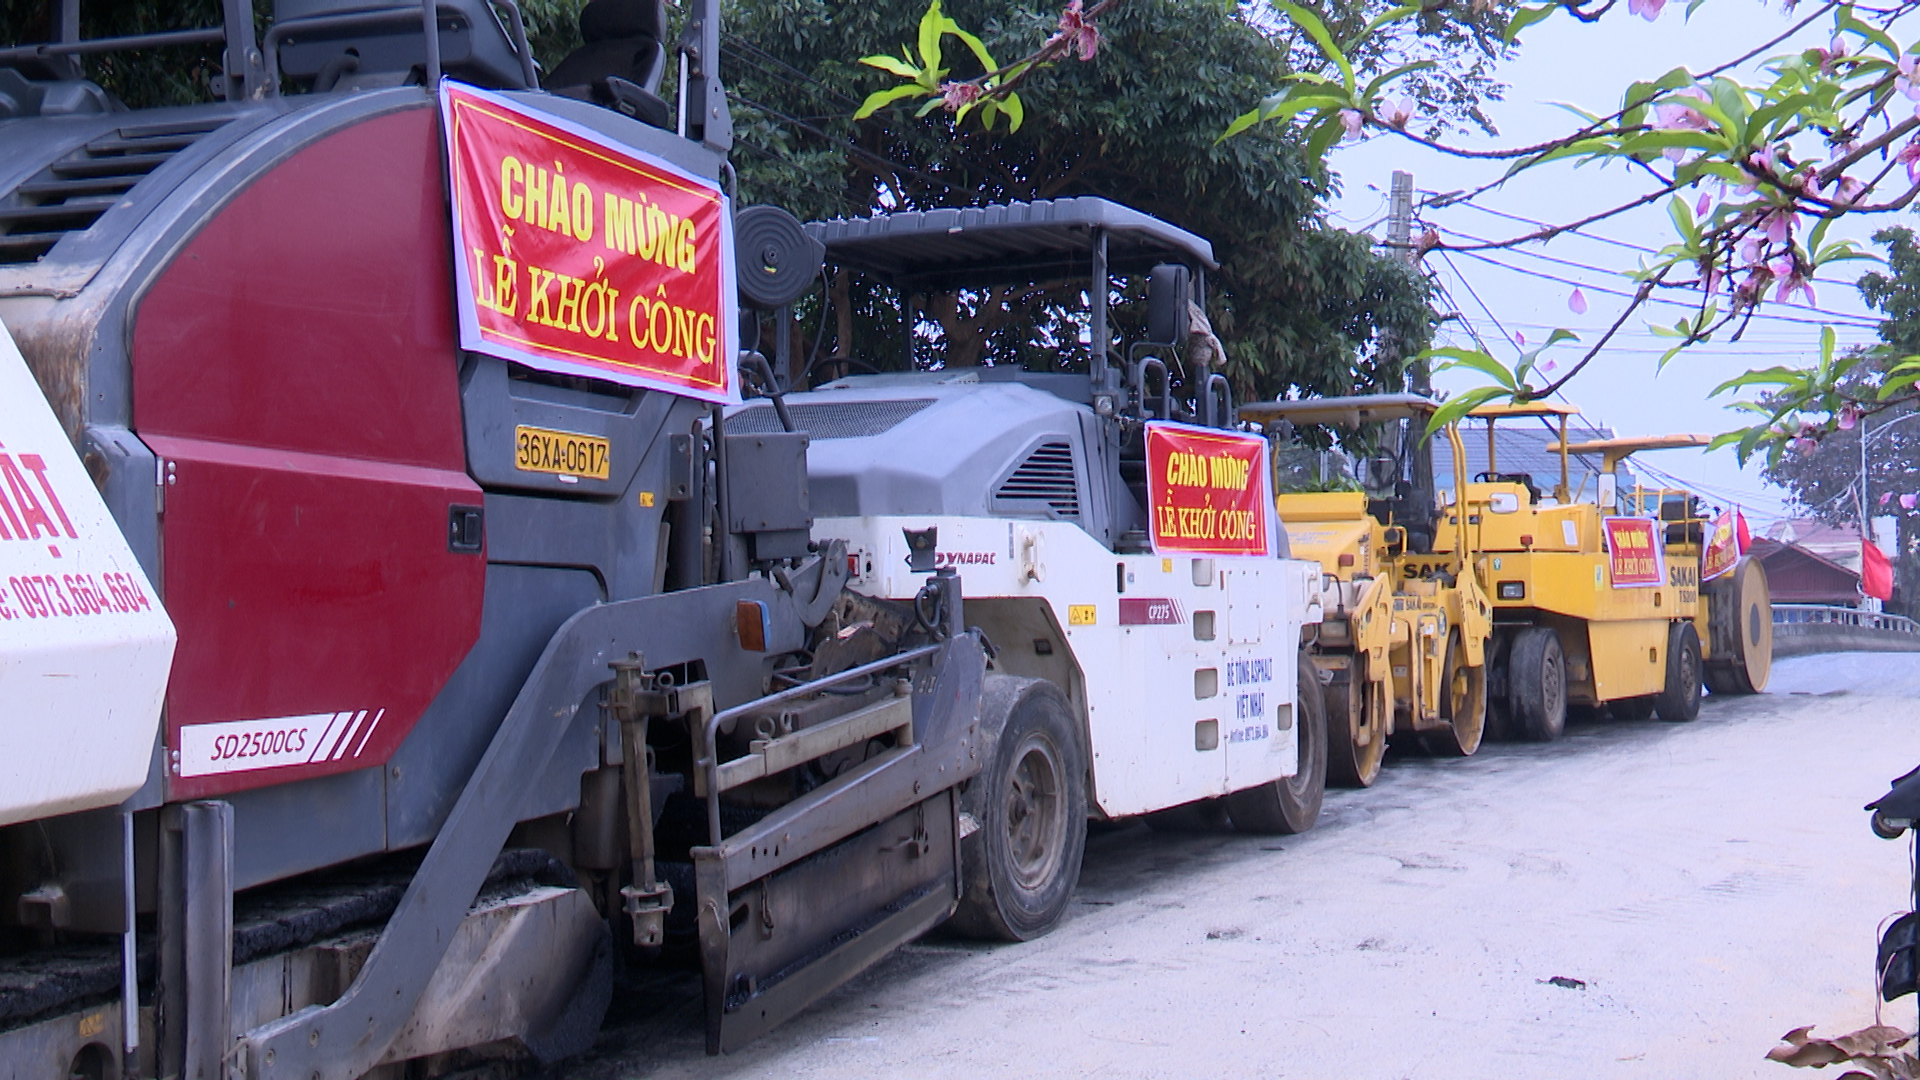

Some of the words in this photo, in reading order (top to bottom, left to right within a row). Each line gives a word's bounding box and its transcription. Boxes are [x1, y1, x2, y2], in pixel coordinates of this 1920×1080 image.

[501, 156, 593, 242] CHÀO
[604, 192, 696, 274] MỪNG
[473, 224, 518, 318] LỄ
[526, 255, 619, 342] KHỞI
[629, 283, 717, 365] CÔNG
[1166, 446, 1208, 488] CHÀO
[1209, 450, 1250, 492] MỪNG
[1157, 488, 1178, 538] LỄ
[1178, 492, 1217, 540] KHỞI
[1218, 500, 1256, 541] CÔNG
[935, 552, 997, 565] DYNAPAC
[1403, 563, 1450, 579] SAK
[1670, 565, 1696, 587] SAKAI
[1148, 604, 1170, 619] CP275
[210, 727, 309, 762] SD2500CS
